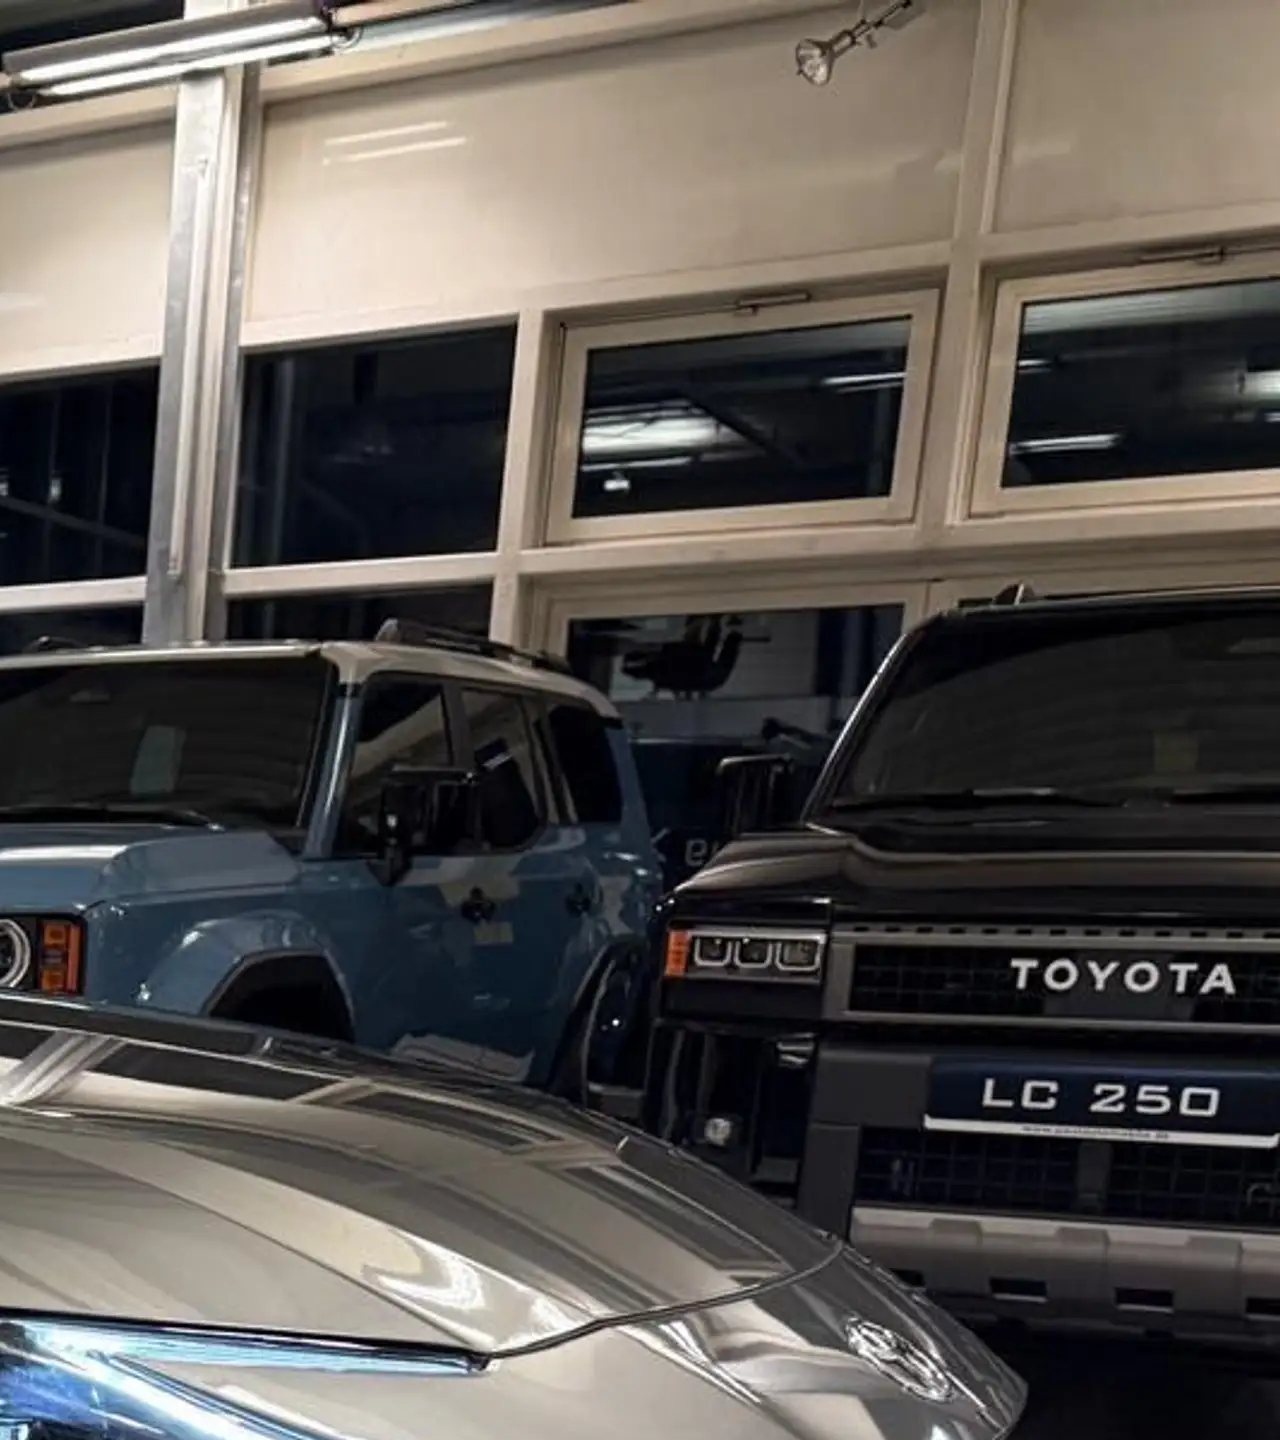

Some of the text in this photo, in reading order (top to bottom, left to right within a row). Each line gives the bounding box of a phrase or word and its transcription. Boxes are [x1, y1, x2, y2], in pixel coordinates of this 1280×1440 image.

[1010, 957, 1236, 995] TOYOTA
[982, 1077, 1221, 1117] LC 250
